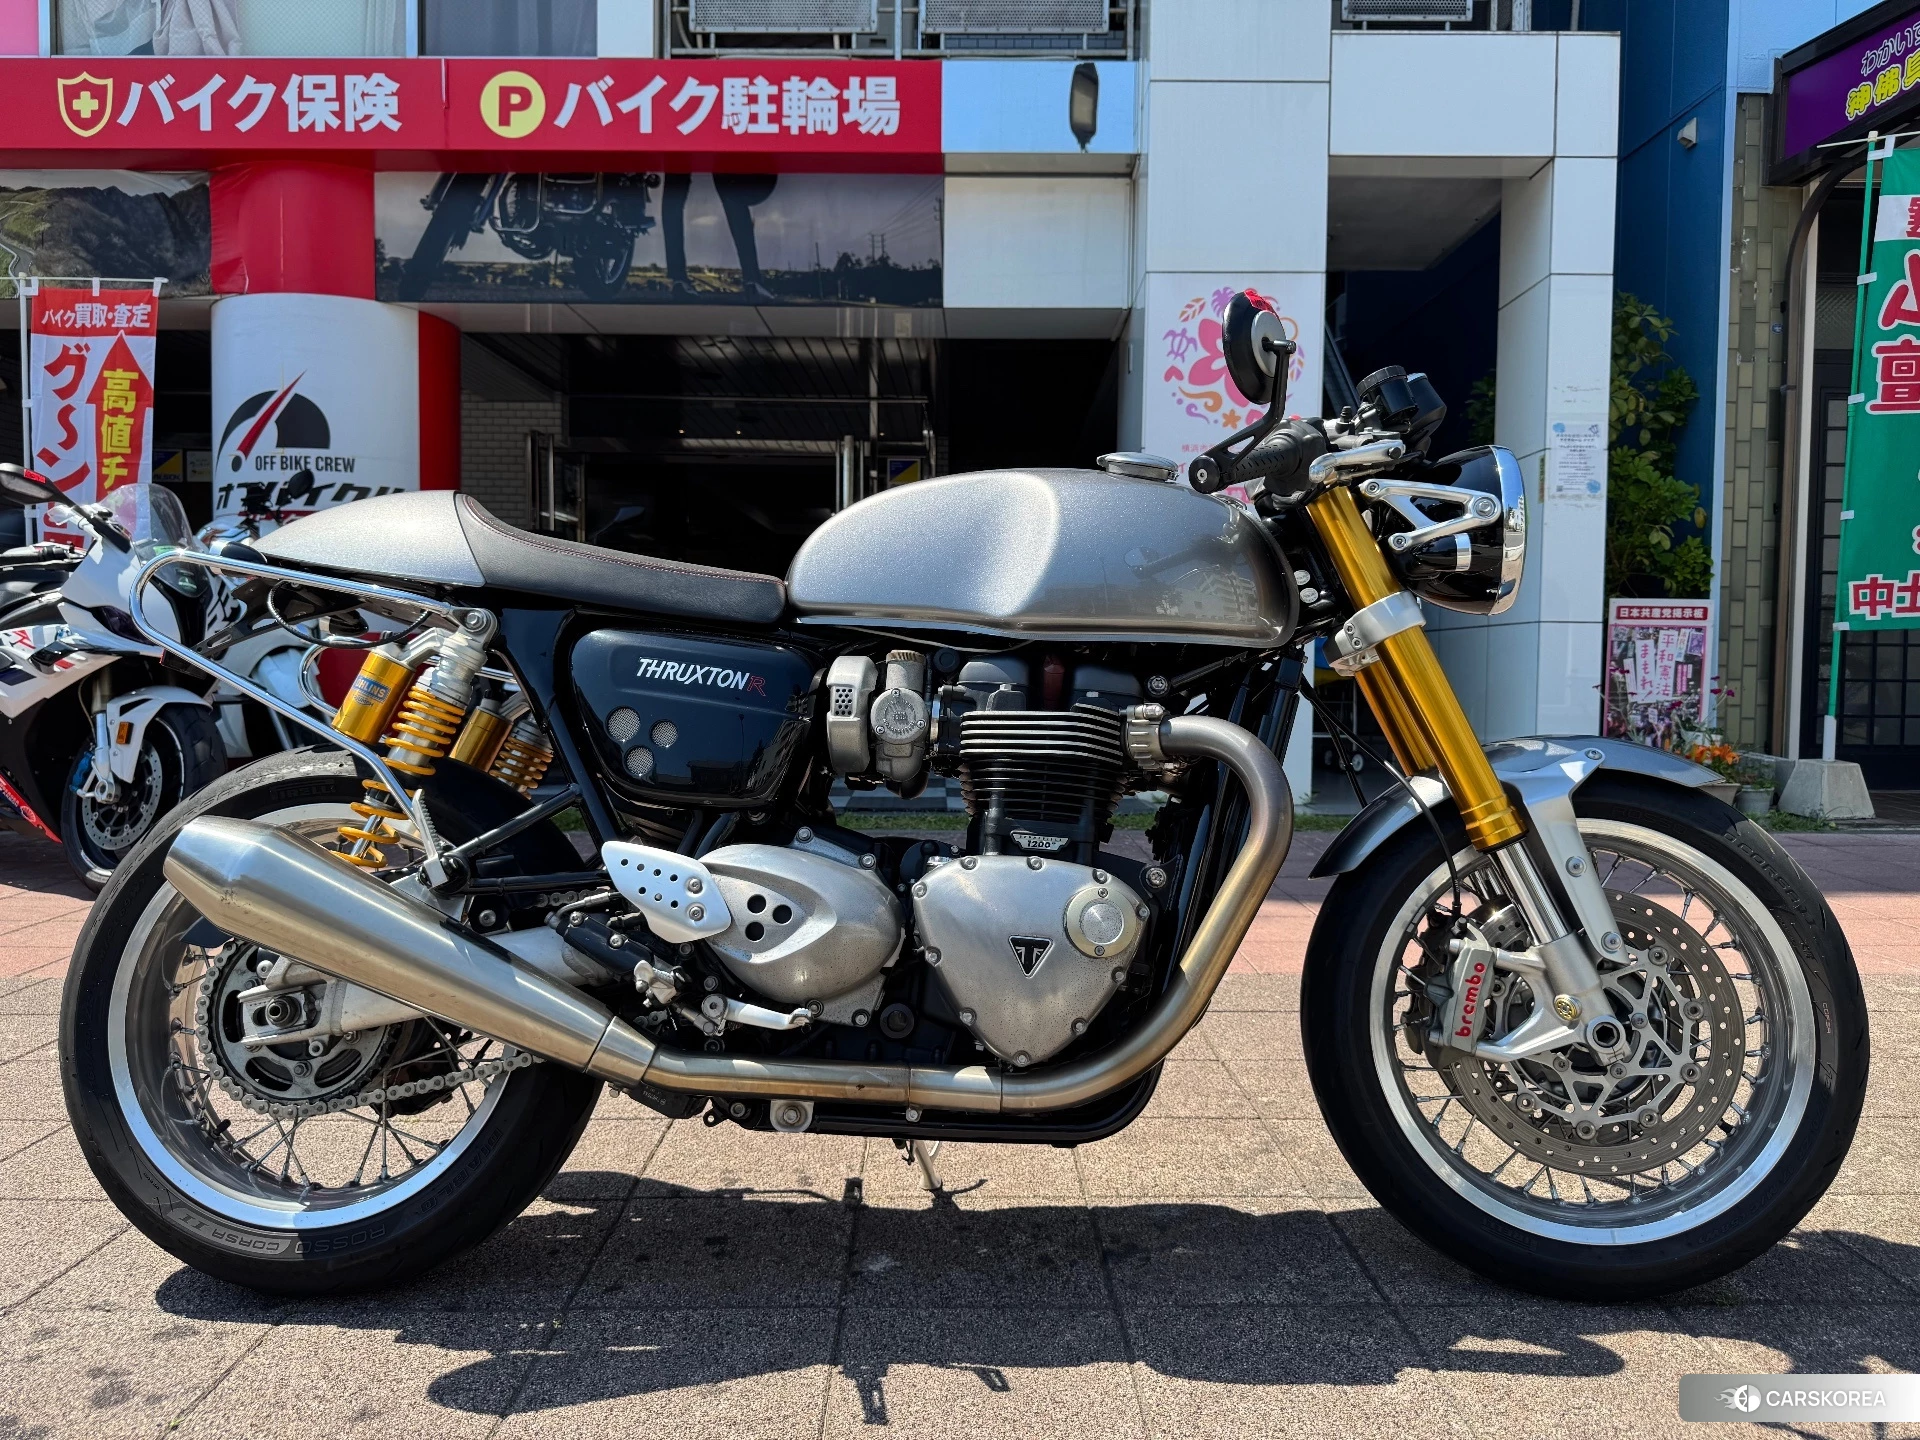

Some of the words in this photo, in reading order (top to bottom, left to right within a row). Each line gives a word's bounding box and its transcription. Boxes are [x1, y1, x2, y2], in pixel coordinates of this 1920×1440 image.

[116, 73, 403, 133] バイク保険
[497, 85, 533, 127] P
[553, 75, 901, 136] バイク駐輪場
[101, 368, 139, 506] 高値チ
[255, 455, 277, 471] OFF
[280, 455, 311, 471] BIKE
[315, 456, 356, 473] CREW
[1619, 606, 1705, 619] 日本共産党掲示板
[636, 656, 750, 690] THRUXTON
[747, 675, 767, 697] R
[1027, 840, 1051, 849] 1200
[1455, 962, 1486, 1037] brembo
[211, 1228, 280, 1251] CORSA
[294, 1223, 386, 1254] ROSSO
